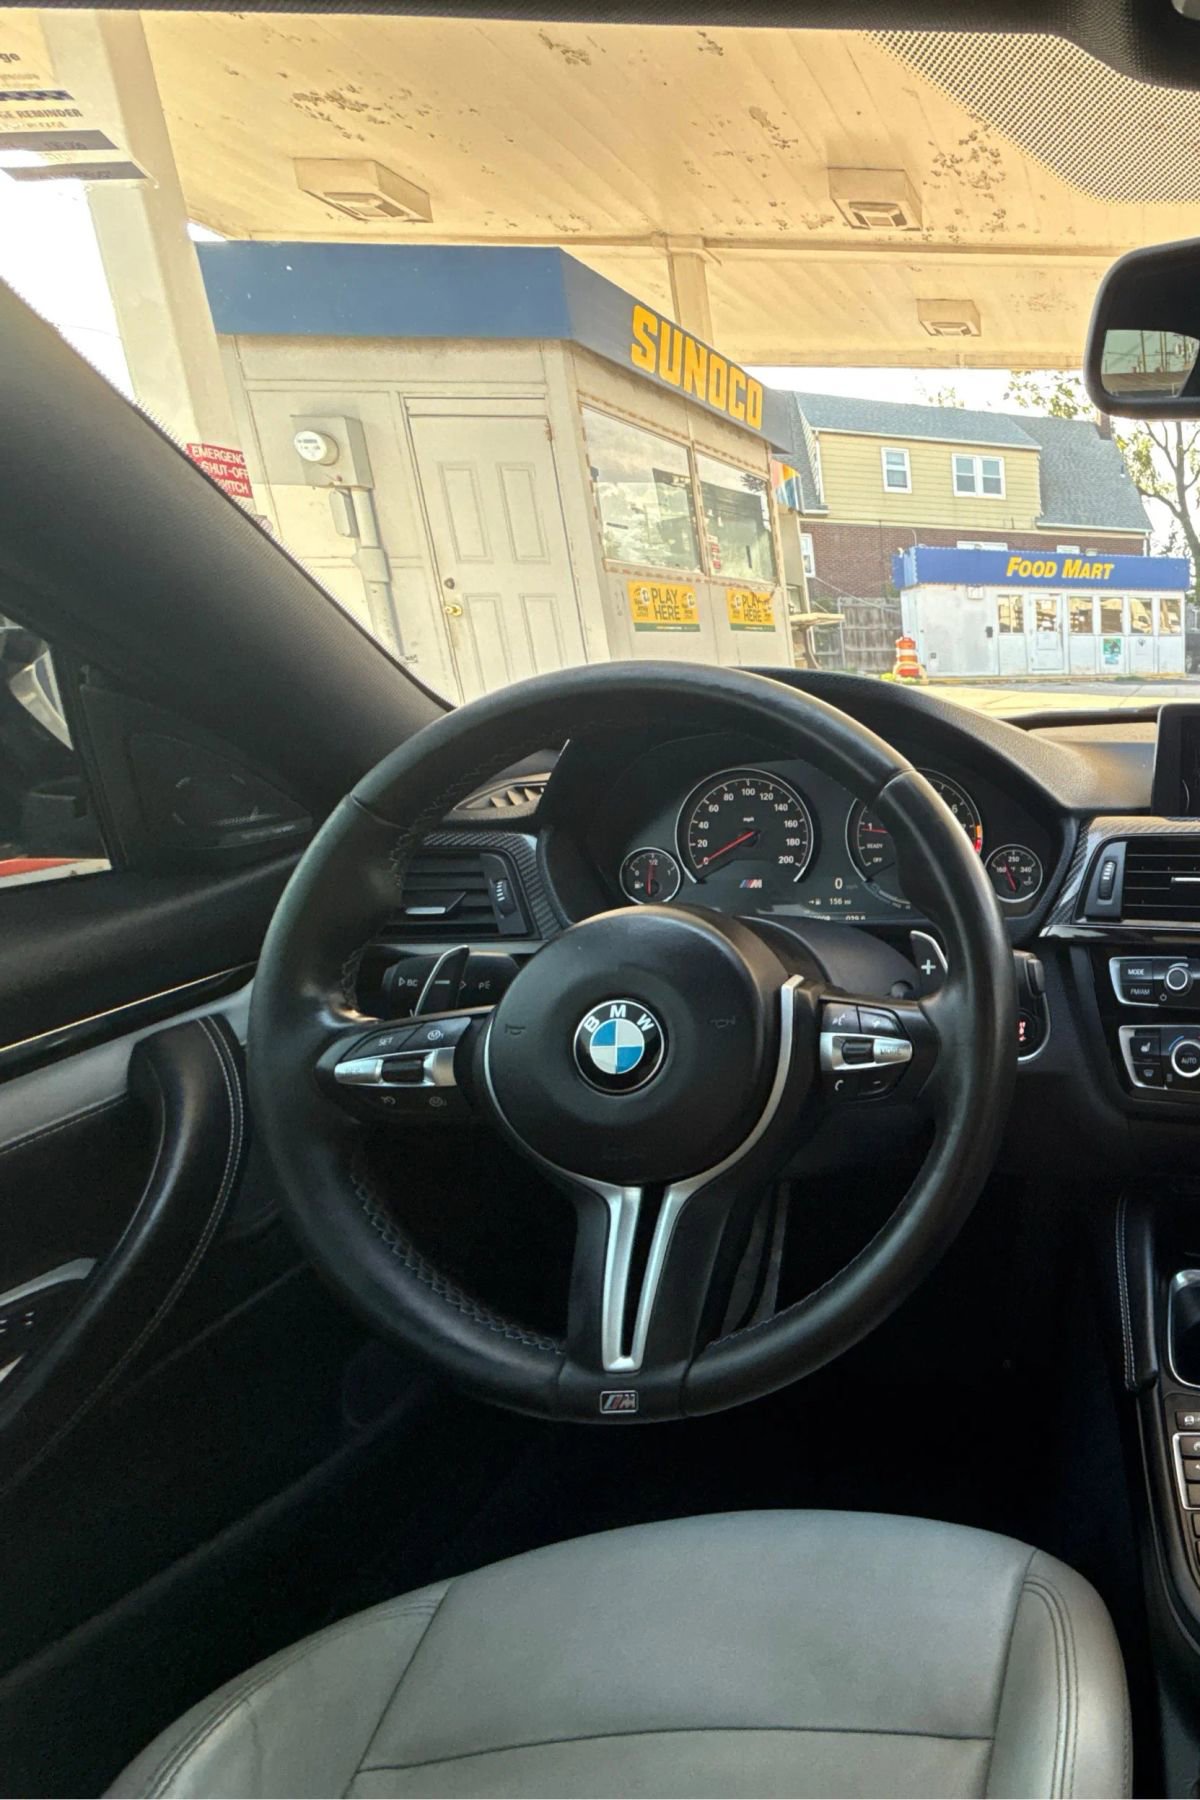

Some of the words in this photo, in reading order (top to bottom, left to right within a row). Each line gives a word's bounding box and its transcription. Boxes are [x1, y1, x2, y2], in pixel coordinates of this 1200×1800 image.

[15, 108, 83, 118] REMINDER
[631, 304, 763, 430] SUNOCO
[651, 587, 678, 604] PLAY
[655, 604, 681, 620] HERE
[698, 821, 709, 829] 40
[784, 820, 798, 828] 160
[786, 838, 800, 846] 180
[778, 856, 794, 864] 200
[834, 878, 843, 889] 0
[584, 1004, 655, 1033] BMW
